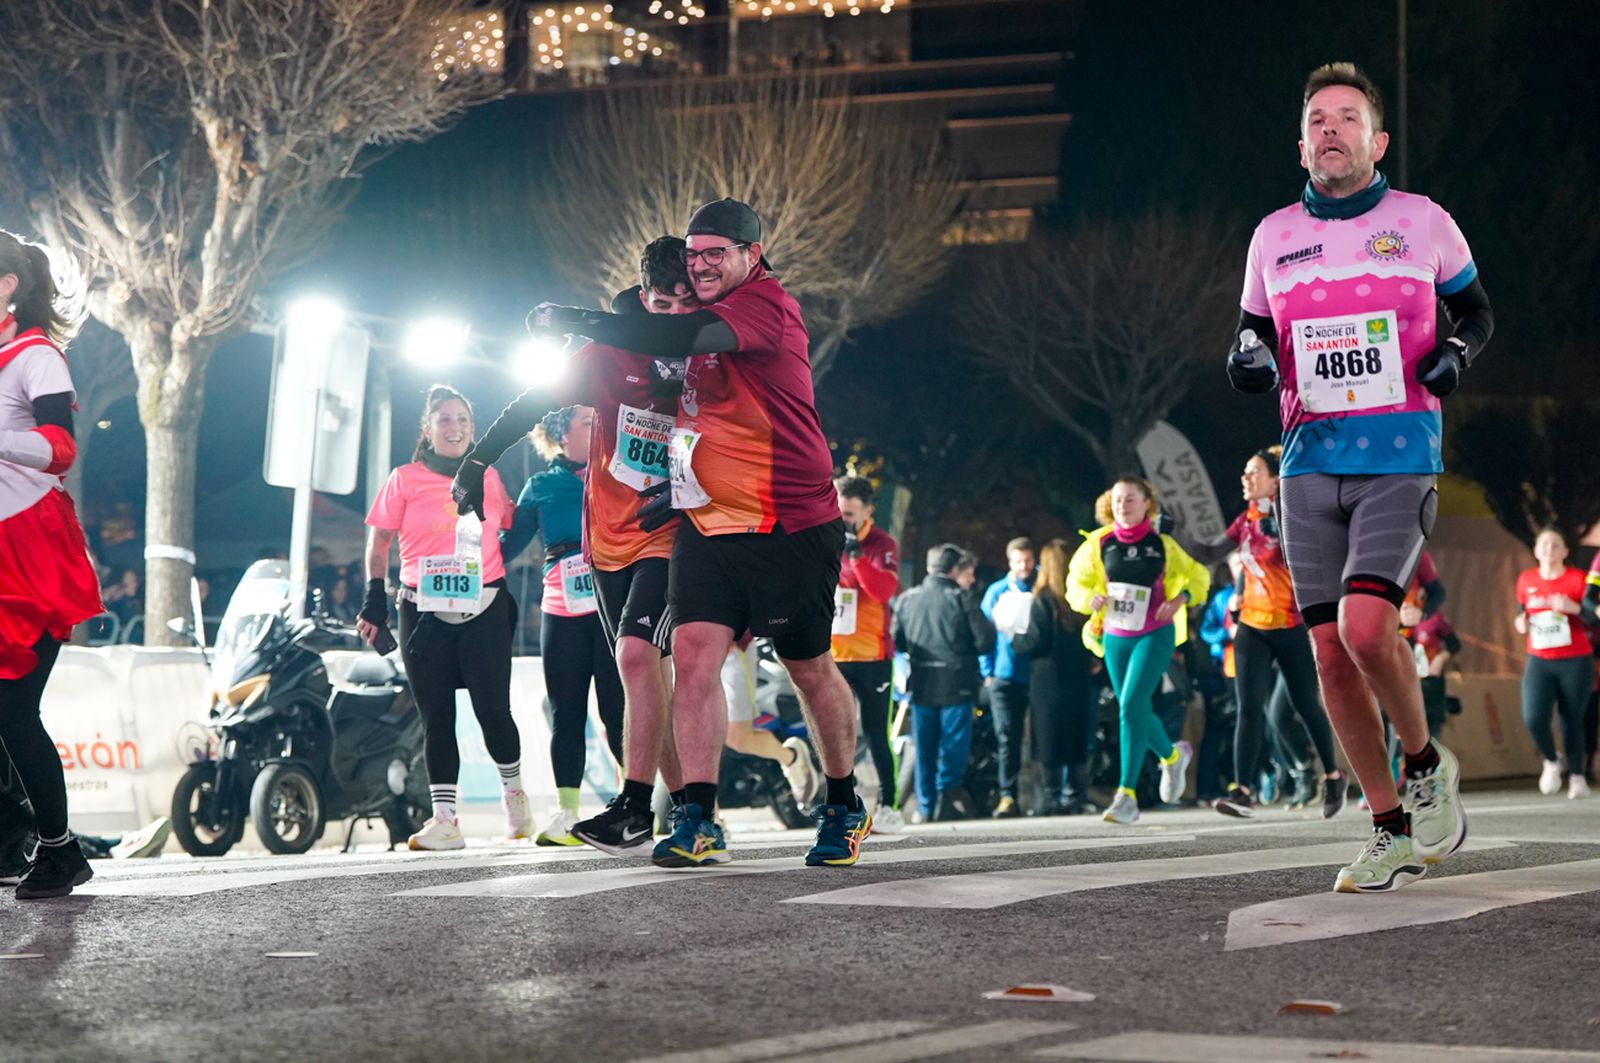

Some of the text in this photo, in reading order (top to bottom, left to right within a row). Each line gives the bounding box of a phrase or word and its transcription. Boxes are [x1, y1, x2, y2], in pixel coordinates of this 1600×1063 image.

[1315, 326, 1358, 339] NOCHE DE
[1306, 341, 1324, 352] SAN
[1326, 337, 1359, 350] ANTÓN
[1315, 347, 1382, 380] 4868
[1346, 378, 1370, 387] Manuel
[623, 425, 642, 437] SAN
[635, 418, 660, 431] NOCHE
[661, 423, 672, 433] DE
[627, 437, 670, 469] 864
[433, 575, 469, 592] 8113
